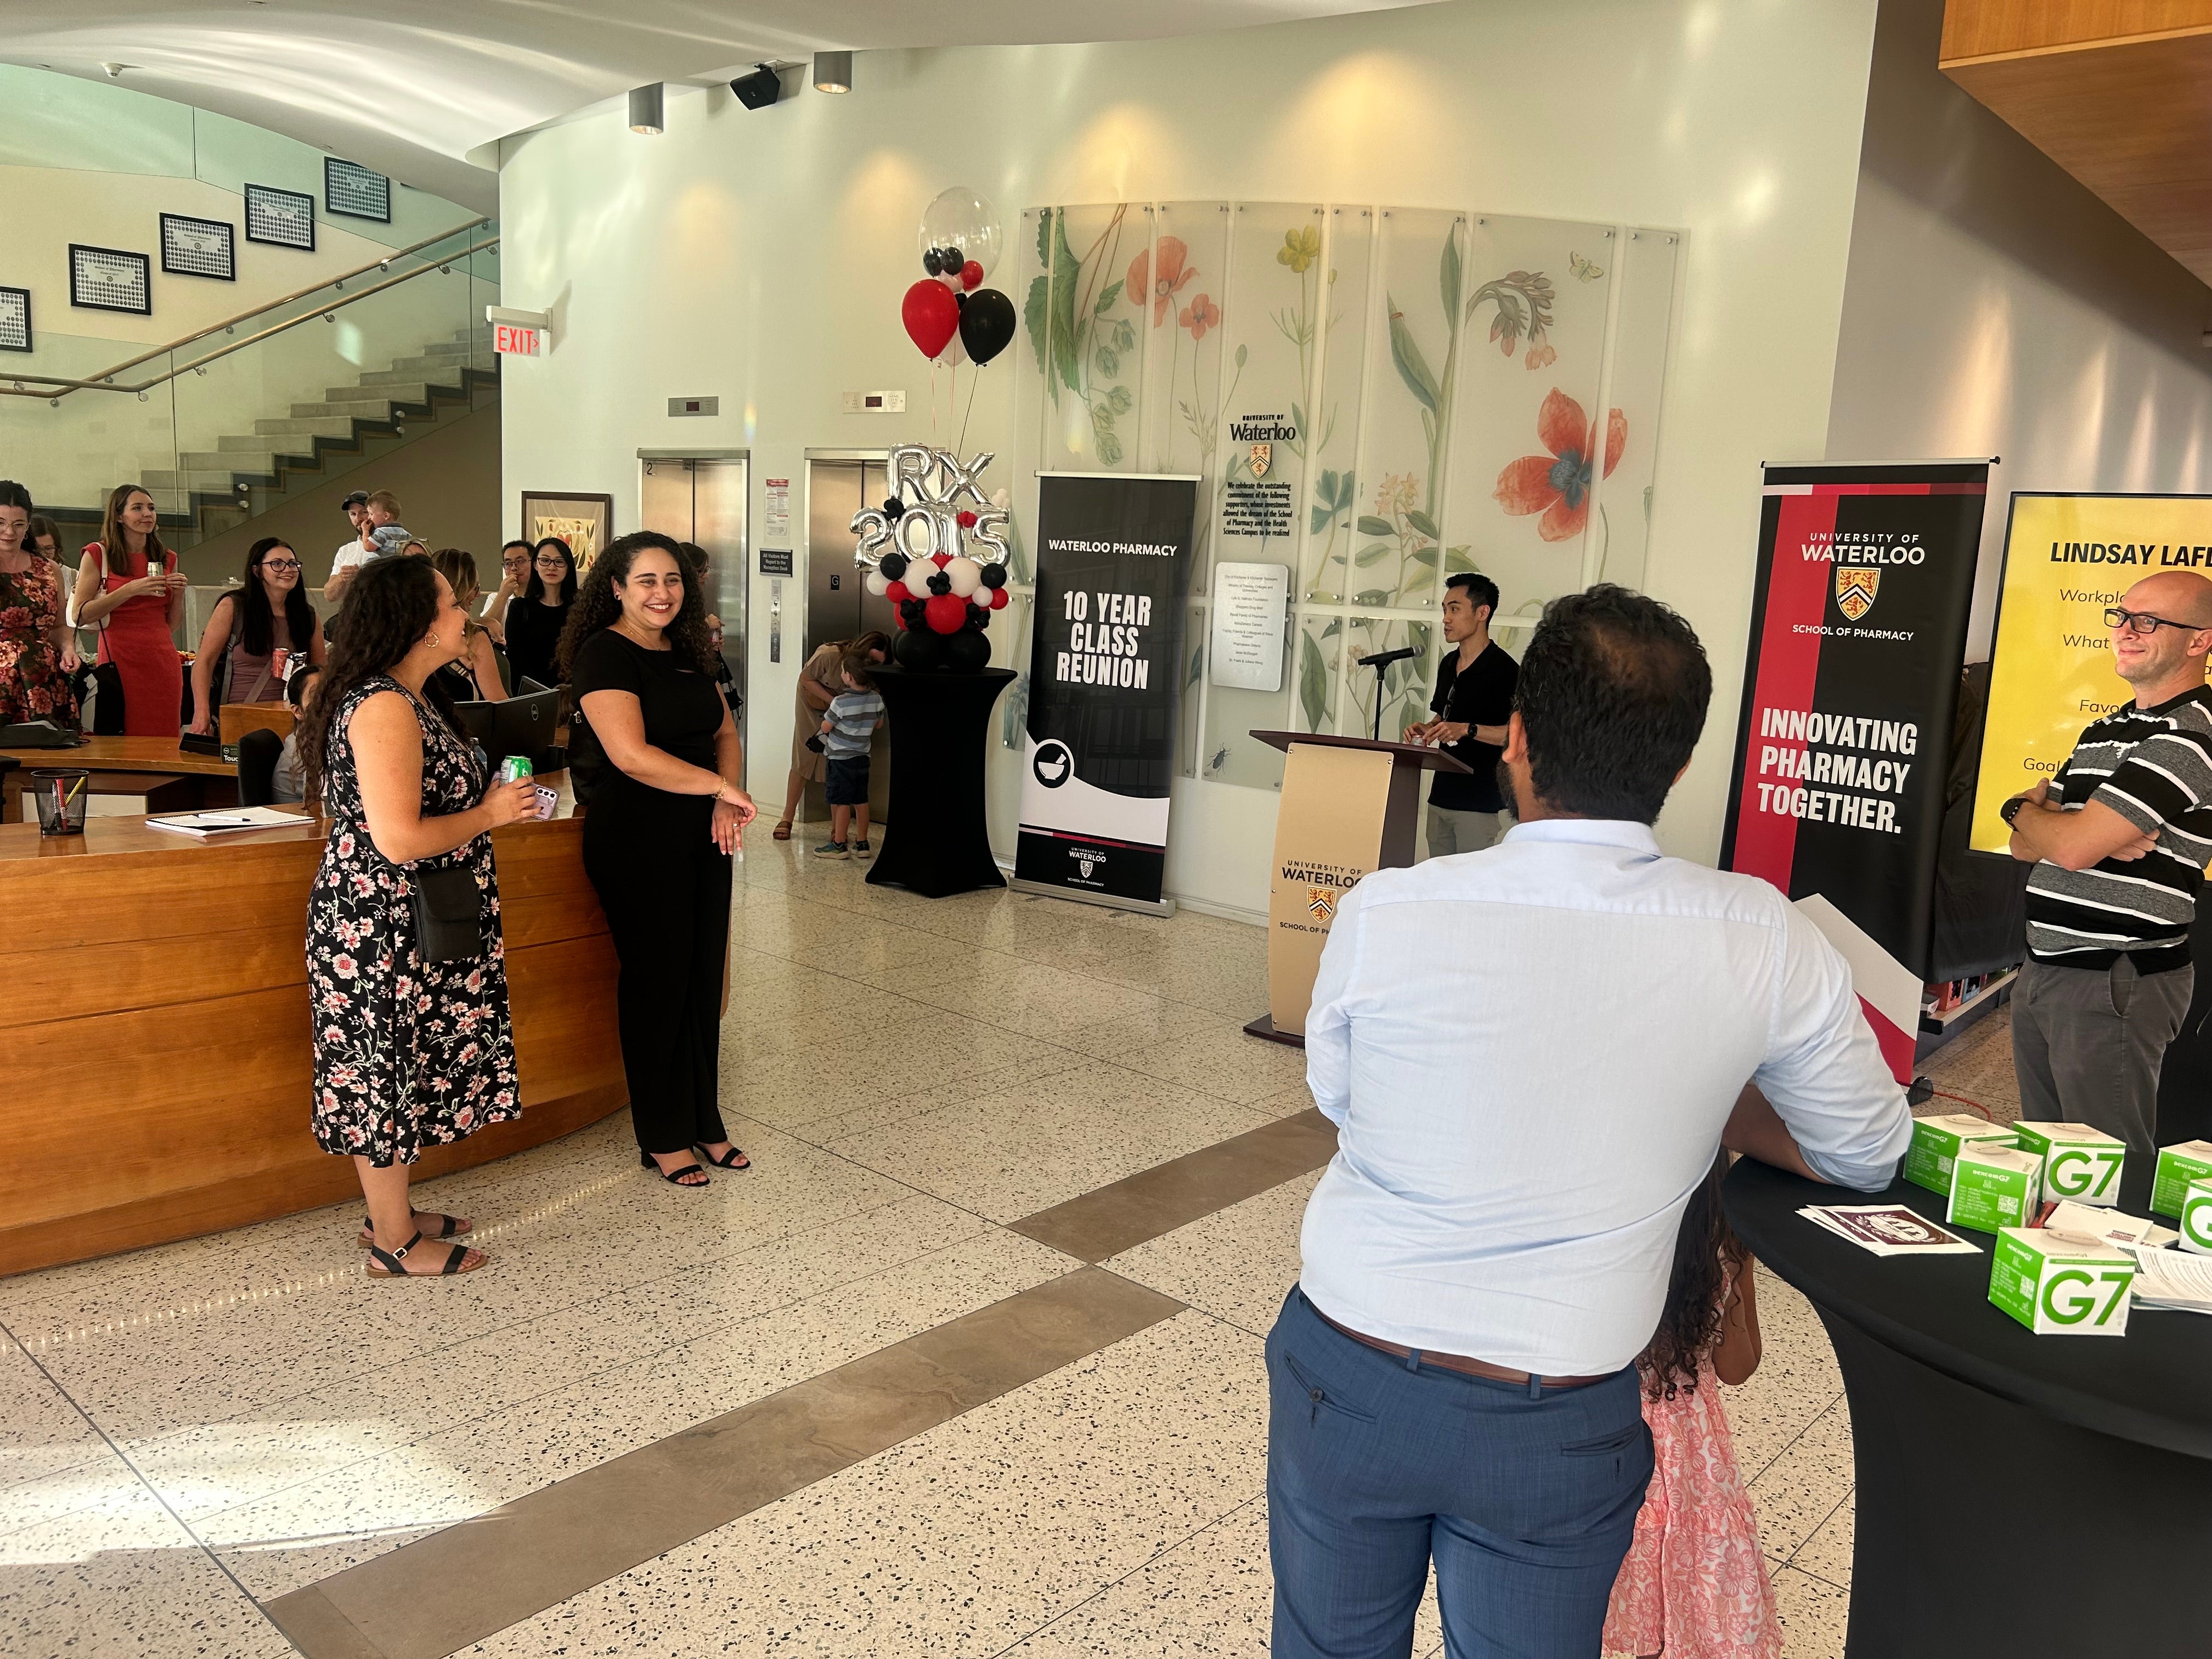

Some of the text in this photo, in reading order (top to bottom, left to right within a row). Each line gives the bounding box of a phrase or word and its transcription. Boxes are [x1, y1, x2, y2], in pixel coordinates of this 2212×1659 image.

[498, 326, 533, 354] EXIT
[1229, 422, 1296, 441] Waterloo
[647, 462, 652, 475] 2
[887, 442, 995, 504] RX
[1265, 482, 1291, 491] outstanding
[1269, 492, 1290, 501] following
[1232, 518, 1254, 528] Pharmacy
[849, 502, 1013, 572] 2015
[1242, 528, 1258, 538] Campus
[1810, 533, 1919, 543] UNIVERSITY OF
[1048, 539, 1177, 556] WATERLOO PHARMACY
[1801, 544, 1925, 565] WATERLOO
[2050, 542, 2156, 565] LINDSAY
[832, 576, 839, 586] G
[1064, 590, 1152, 627] 10 YEAR
[1070, 622, 1139, 657] CLASS
[1792, 624, 1914, 641] SCHOOL OF PHARMACY
[2063, 634, 2110, 648] What
[1056, 652, 1149, 690] REUNION
[1760, 708, 1918, 755] INNOVATING
[1759, 745, 1911, 794] PHARMACY
[1757, 782, 1901, 834] TOGETHER.
[1069, 850, 1106, 862] WATERLOO
[1288, 860, 1345, 873] UNIVERSITY
[1280, 922, 1308, 932] SCHOOL
[2048, 1150, 2124, 1198] G7
[2041, 1269, 2135, 1325] G7
